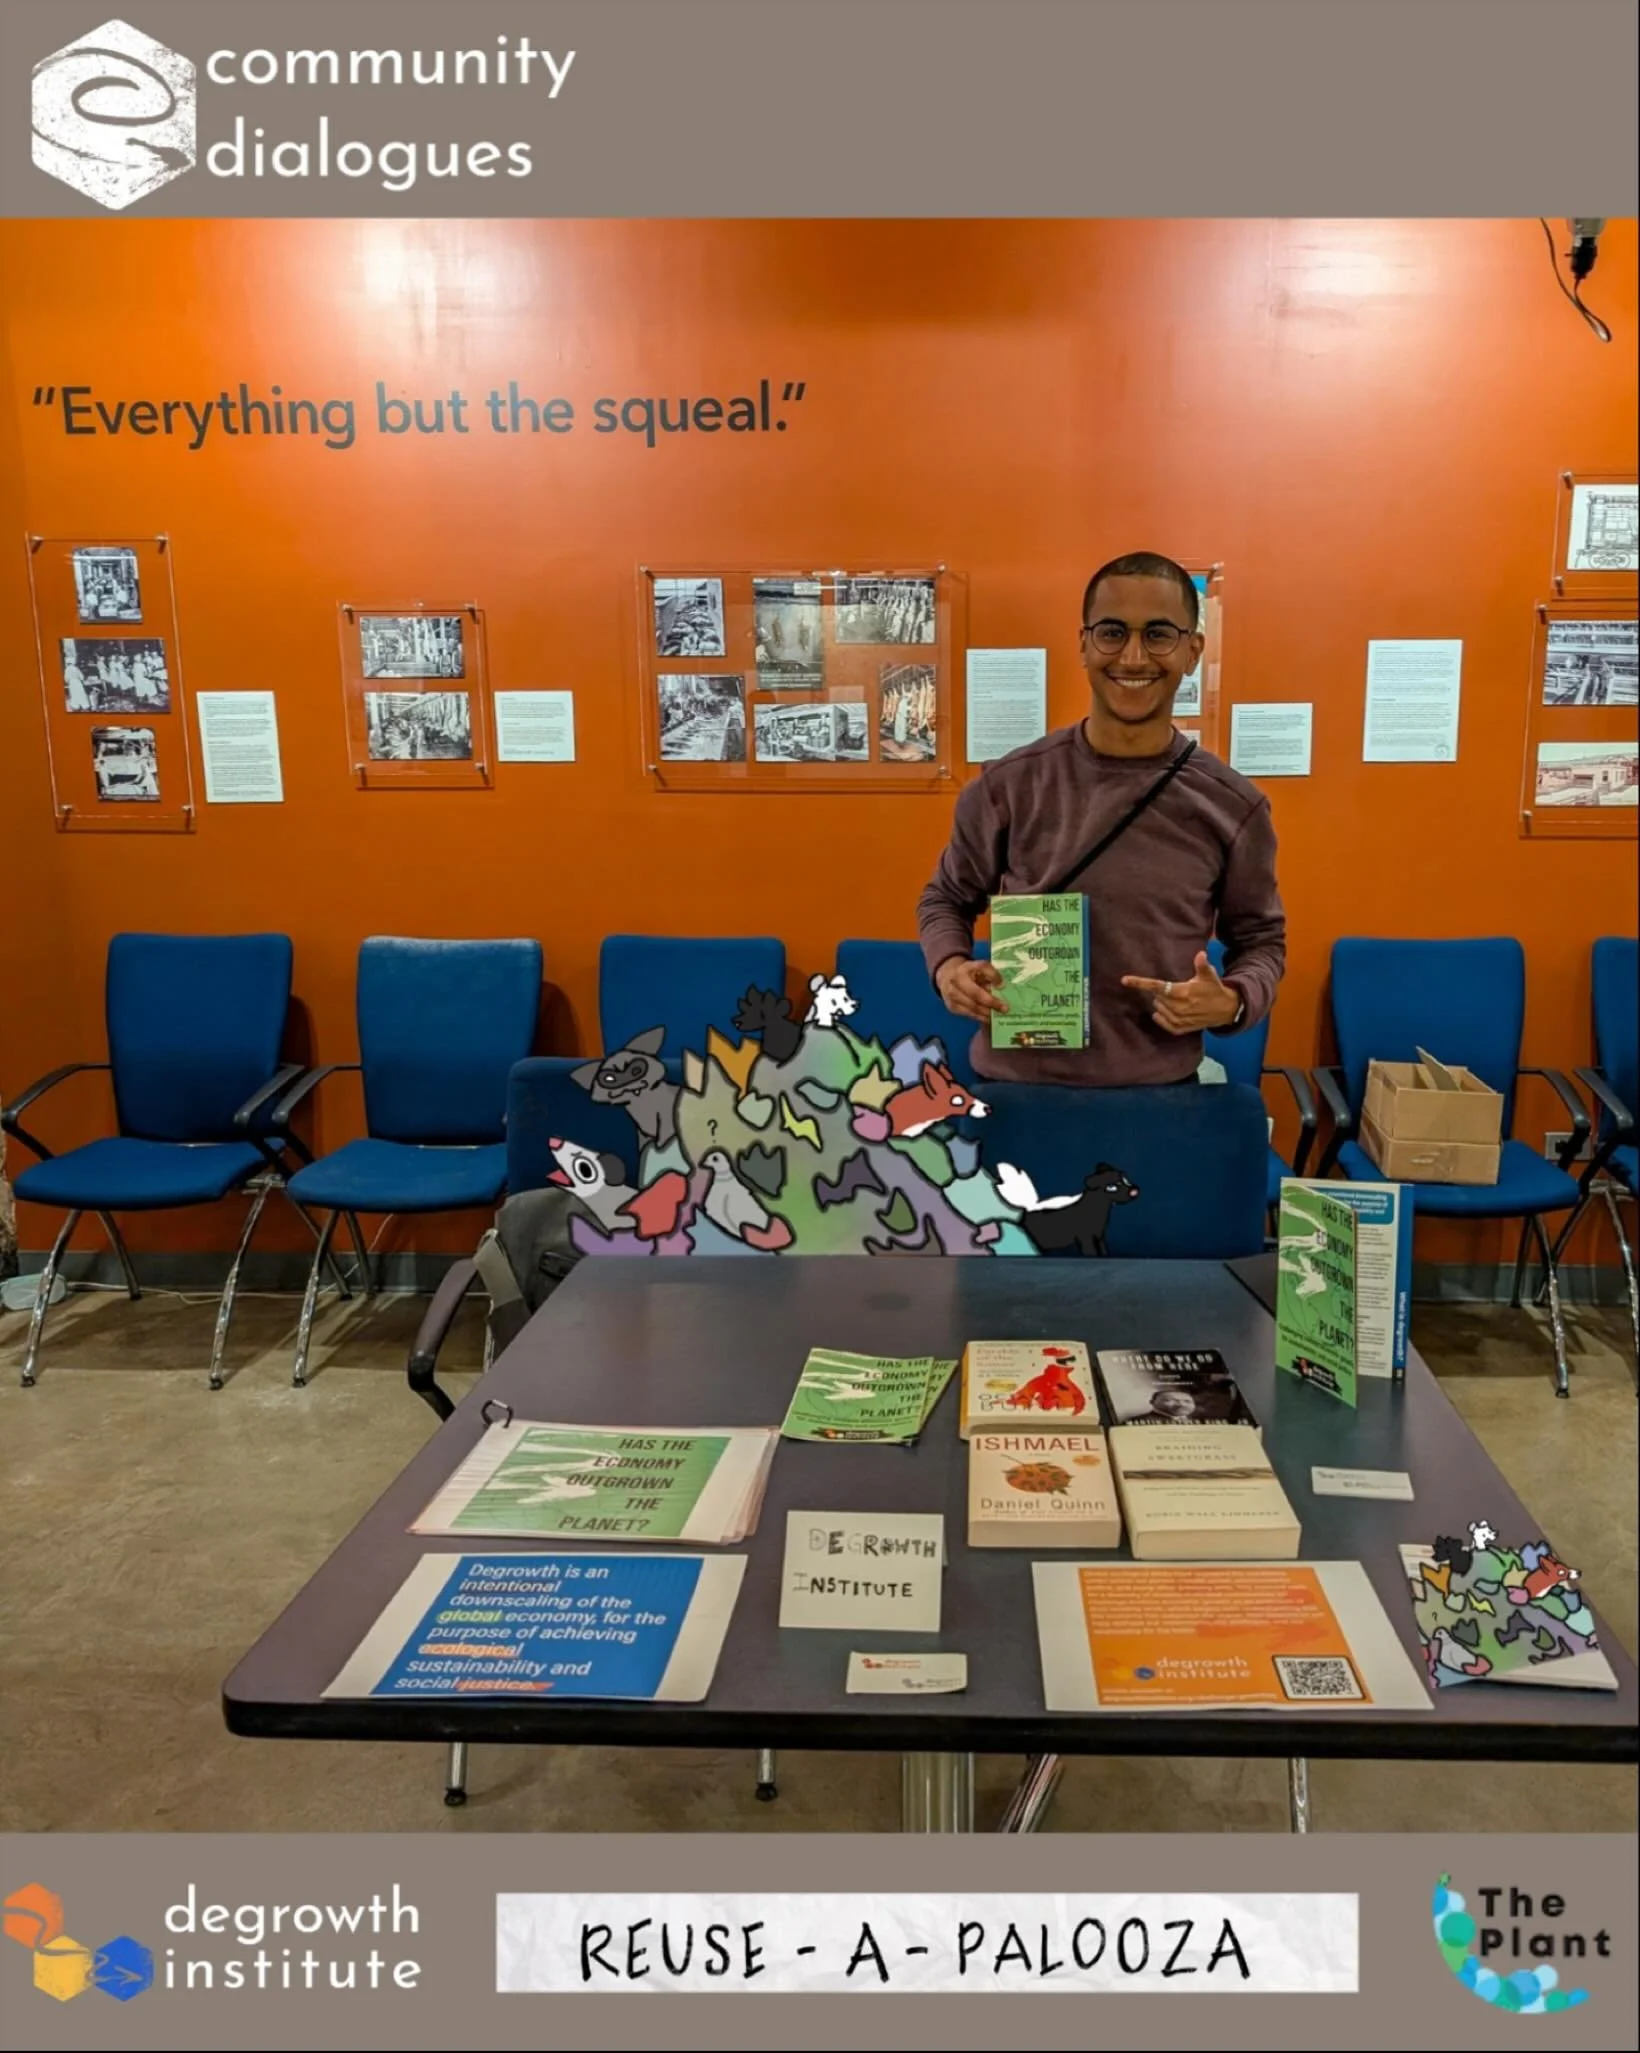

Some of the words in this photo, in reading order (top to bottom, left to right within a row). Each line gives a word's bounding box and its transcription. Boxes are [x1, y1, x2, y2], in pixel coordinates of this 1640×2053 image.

[377, 382, 468, 434] but
[486, 383, 574, 433] the
[1042, 900, 1062, 912] HAS
[1064, 899, 1080, 911] THE
[1036, 924, 1080, 936] ECONOMY
[1029, 948, 1080, 960] OUTGROWN
[1065, 971, 1080, 983] THE
[1041, 994, 1080, 1008] PLANET?
[1321, 1202, 1340, 1226] HAS
[1338, 1208, 1353, 1230] THE
[1316, 1229, 1353, 1262] ECONOMY
[1311, 1258, 1353, 1294] OUTGROWN
[1340, 1302, 1353, 1324] THE
[1320, 1320, 1354, 1353] PLANET?
[908, 1359, 928, 1367] THE
[864, 1371, 928, 1380] ECONOMY
[852, 1382, 927, 1392] OUTGROWN
[900, 1394, 922, 1403] THE
[860, 1405, 921, 1417] PLANET?
[619, 1439, 655, 1450] HAS
[660, 1439, 695, 1451] THE
[976, 1437, 1099, 1451] ISHMAEL
[592, 1456, 686, 1469] ECONOMY
[566, 1475, 675, 1489] OUTGROWN
[624, 1498, 663, 1511] THE
[981, 1499, 1040, 1509] Daniel
[1051, 1499, 1105, 1510] Quinn
[558, 1517, 651, 1530] PLANET?
[809, 1528, 937, 1558] DEGROWTH
[468, 1563, 561, 1579] Degrowth
[564, 1564, 581, 1578] is
[585, 1568, 609, 1578] an
[459, 1579, 561, 1592] intentional
[793, 1573, 913, 1598] INSTITUTE
[450, 1594, 573, 1609] downscaling
[576, 1595, 598, 1608] of
[601, 1596, 632, 1608] the
[439, 1610, 502, 1624] global
[504, 1612, 598, 1626] economy,
[602, 1611, 630, 1624] for
[634, 1612, 666, 1625] the
[427, 1628, 512, 1640] purpose
[516, 1626, 538, 1638] of
[541, 1627, 638, 1642] achieving
[418, 1642, 524, 1657] ecological
[407, 1659, 546, 1676] sustainability
[550, 1661, 591, 1675] and
[1156, 1656, 1247, 1669] degrowth
[1158, 1668, 1251, 1679] institute
[394, 1677, 459, 1690] social
